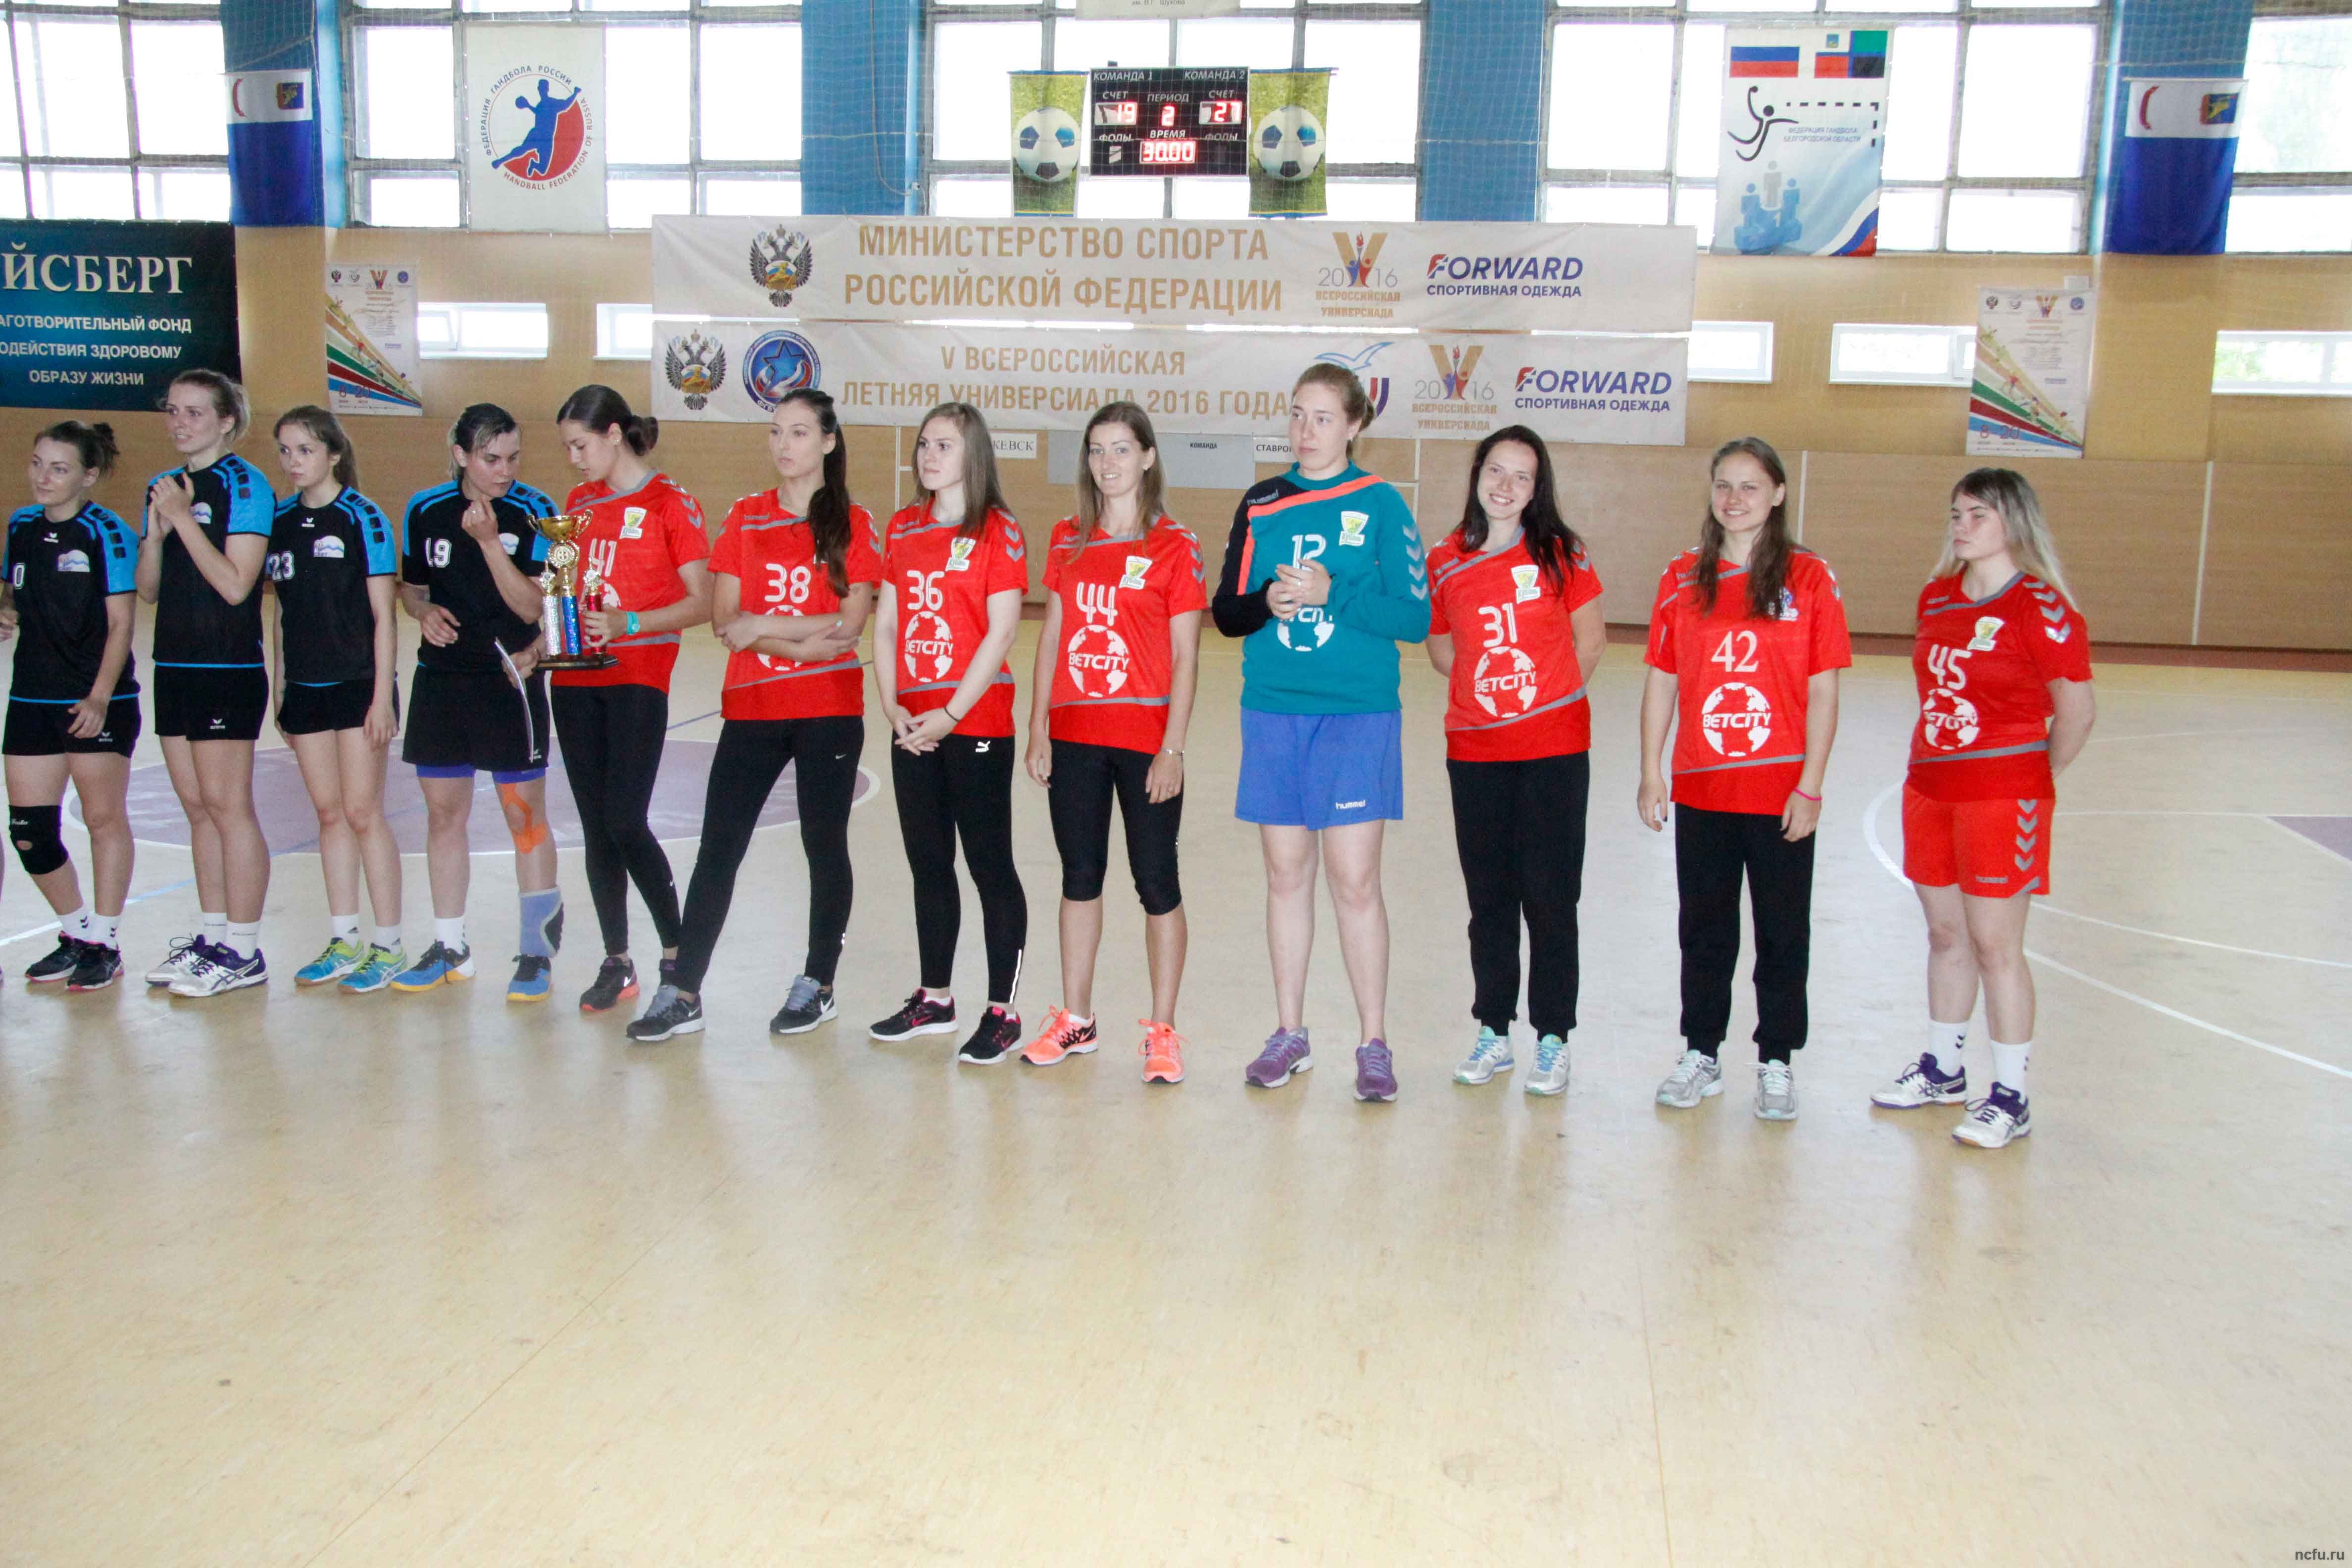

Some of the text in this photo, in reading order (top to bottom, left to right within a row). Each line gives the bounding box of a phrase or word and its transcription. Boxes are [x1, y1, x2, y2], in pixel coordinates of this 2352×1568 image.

[1093, 71, 1153, 82] КОМАНДА 1
[1184, 70, 1245, 81] КОМАНДА 2
[1102, 91, 1128, 99] СЧЕТ
[1147, 93, 1190, 103] ПЕРИОД
[1208, 90, 1235, 98] СЧЕТ
[481, 65, 572, 155] ФЕДЕРАЦИЯ ГАНДБОЛА РОССИИ
[1117, 102, 1135, 123] 19
[1161, 105, 1175, 127] 2
[503, 98, 592, 190] HANDBALL FEDERATION OF RUSSIA
[1149, 129, 1186, 139] ВРЕМЯ
[859, 225, 1269, 260] МИНИСТЕРСТВО СПОРТА
[1426, 253, 1583, 280] FORWARD
[844, 268, 1282, 316] РОССИЙСКОЙ ФЕДЕРАЦИИ
[1315, 290, 1401, 301] ВСЕРОССИЙСКАЯ
[1426, 284, 1582, 298] СПОРТИВНАЯ ОДЕЖДА
[1322, 306, 1393, 319] УНИВЕРСИАДА
[148, 318, 193, 334] ФОНД
[90, 345, 182, 359] ЗДОРОВОМУ
[941, 343, 1185, 375] V ВСЕРОССИЙСКАЯ
[29, 369, 144, 386] ОБРАЗУ ЖИЗНИ
[1515, 366, 1671, 394] FORWARD
[841, 382, 939, 406] ЛЕТНЯЯ
[1147, 390, 1209, 415] 2016
[1219, 390, 1288, 420] ГОДА
[1515, 397, 1670, 412] СПОРТИВНАЯ ОДЕЖДА
[1255, 444, 1291, 453] СТАВРО
[425, 537, 452, 568] 19
[588, 538, 618, 578] 41
[1291, 534, 1326, 572] 12
[268, 550, 295, 582] 23
[764, 563, 812, 604] 38
[906, 570, 945, 611] 36
[1076, 582, 1118, 626] 44
[1478, 602, 1518, 648] 31
[905, 639, 954, 656] BETCITY
[1711, 630, 1759, 673] 42
[1069, 652, 1129, 671] BETCITY
[1927, 643, 1972, 690] 45
[1474, 670, 1536, 693] BETCITY
[1702, 712, 1772, 729] BETCITY
[1335, 799, 1366, 810] hummel
